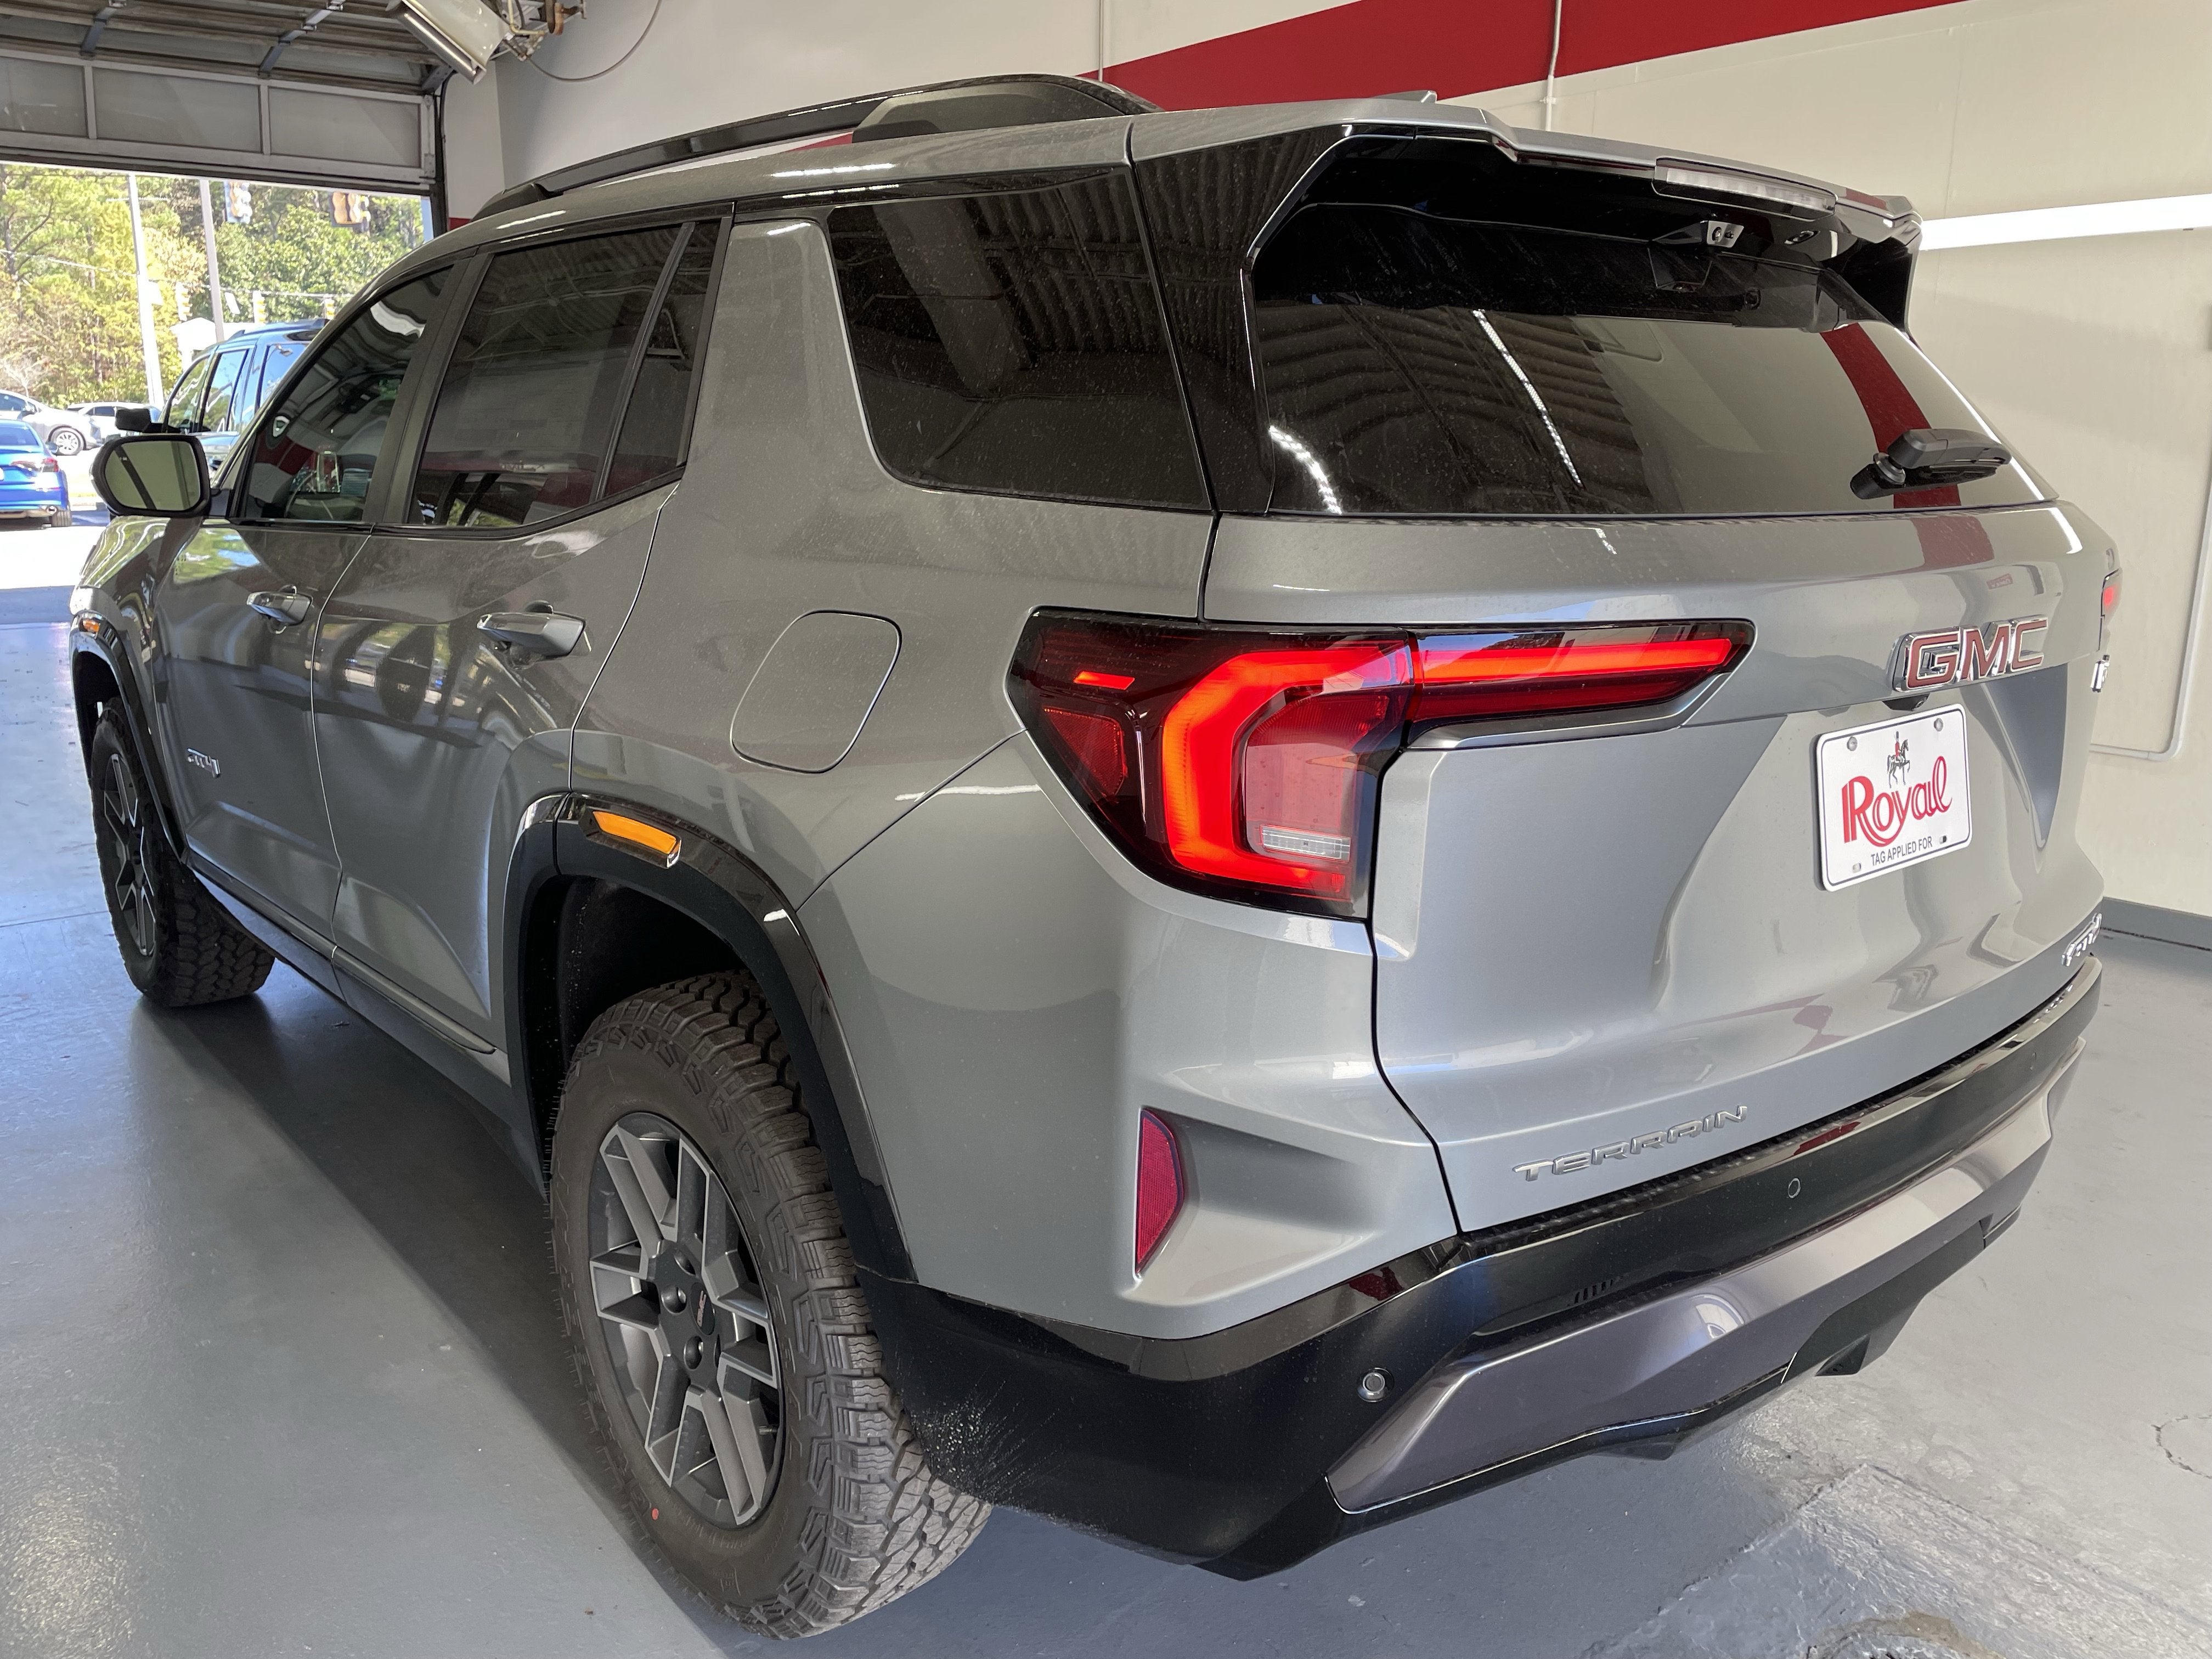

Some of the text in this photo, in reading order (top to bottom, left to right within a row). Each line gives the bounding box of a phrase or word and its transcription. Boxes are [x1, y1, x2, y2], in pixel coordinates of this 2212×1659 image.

[1894, 614, 2048, 692] GMC
[1842, 756, 1953, 847] Royal
[1870, 836, 1933, 866] TAG APPLIED FOR
[1513, 1105, 1748, 1181] TERRAIN
